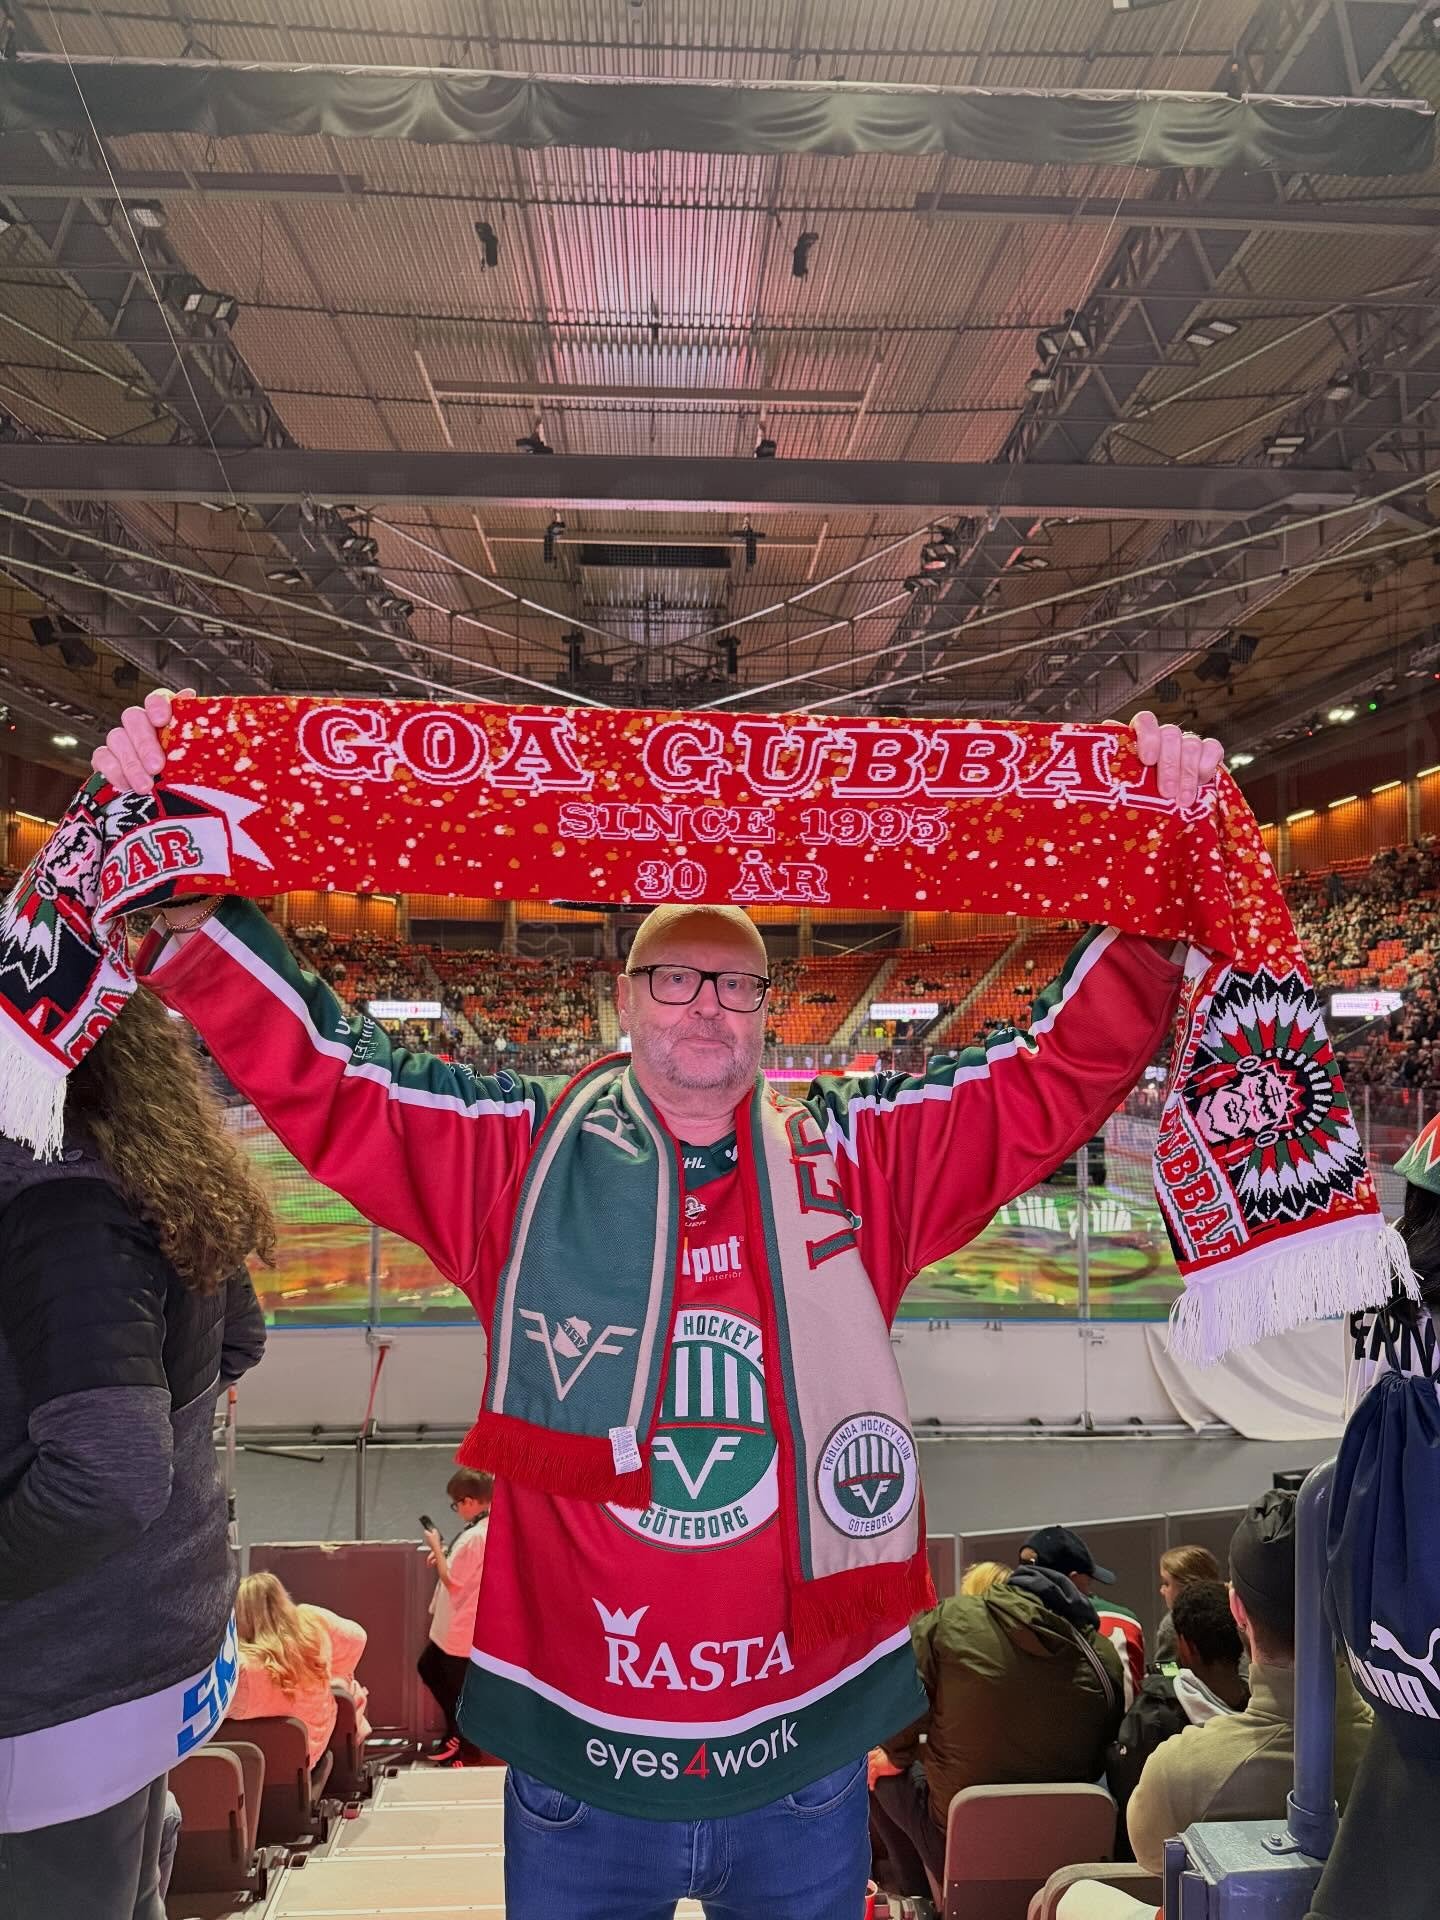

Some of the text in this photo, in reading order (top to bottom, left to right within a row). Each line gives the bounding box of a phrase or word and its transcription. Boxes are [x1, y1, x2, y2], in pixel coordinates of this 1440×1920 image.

[299, 705, 1217, 823] GOA GUBBA
[558, 802, 948, 846] SINCE 1995
[99, 824, 203, 908] BAR
[635, 850, 829, 901] 30 ÅR
[682, 1156, 705, 1169] HL
[683, 1314, 759, 1350] HOCKEY
[860, 1419, 897, 1437] HOCKEY
[896, 1435, 911, 1461] CLUB
[637, 1505, 749, 1540] GÖTEBORG
[604, 1631, 795, 1692] RASTA
[585, 1718, 800, 1781] eyes4work
